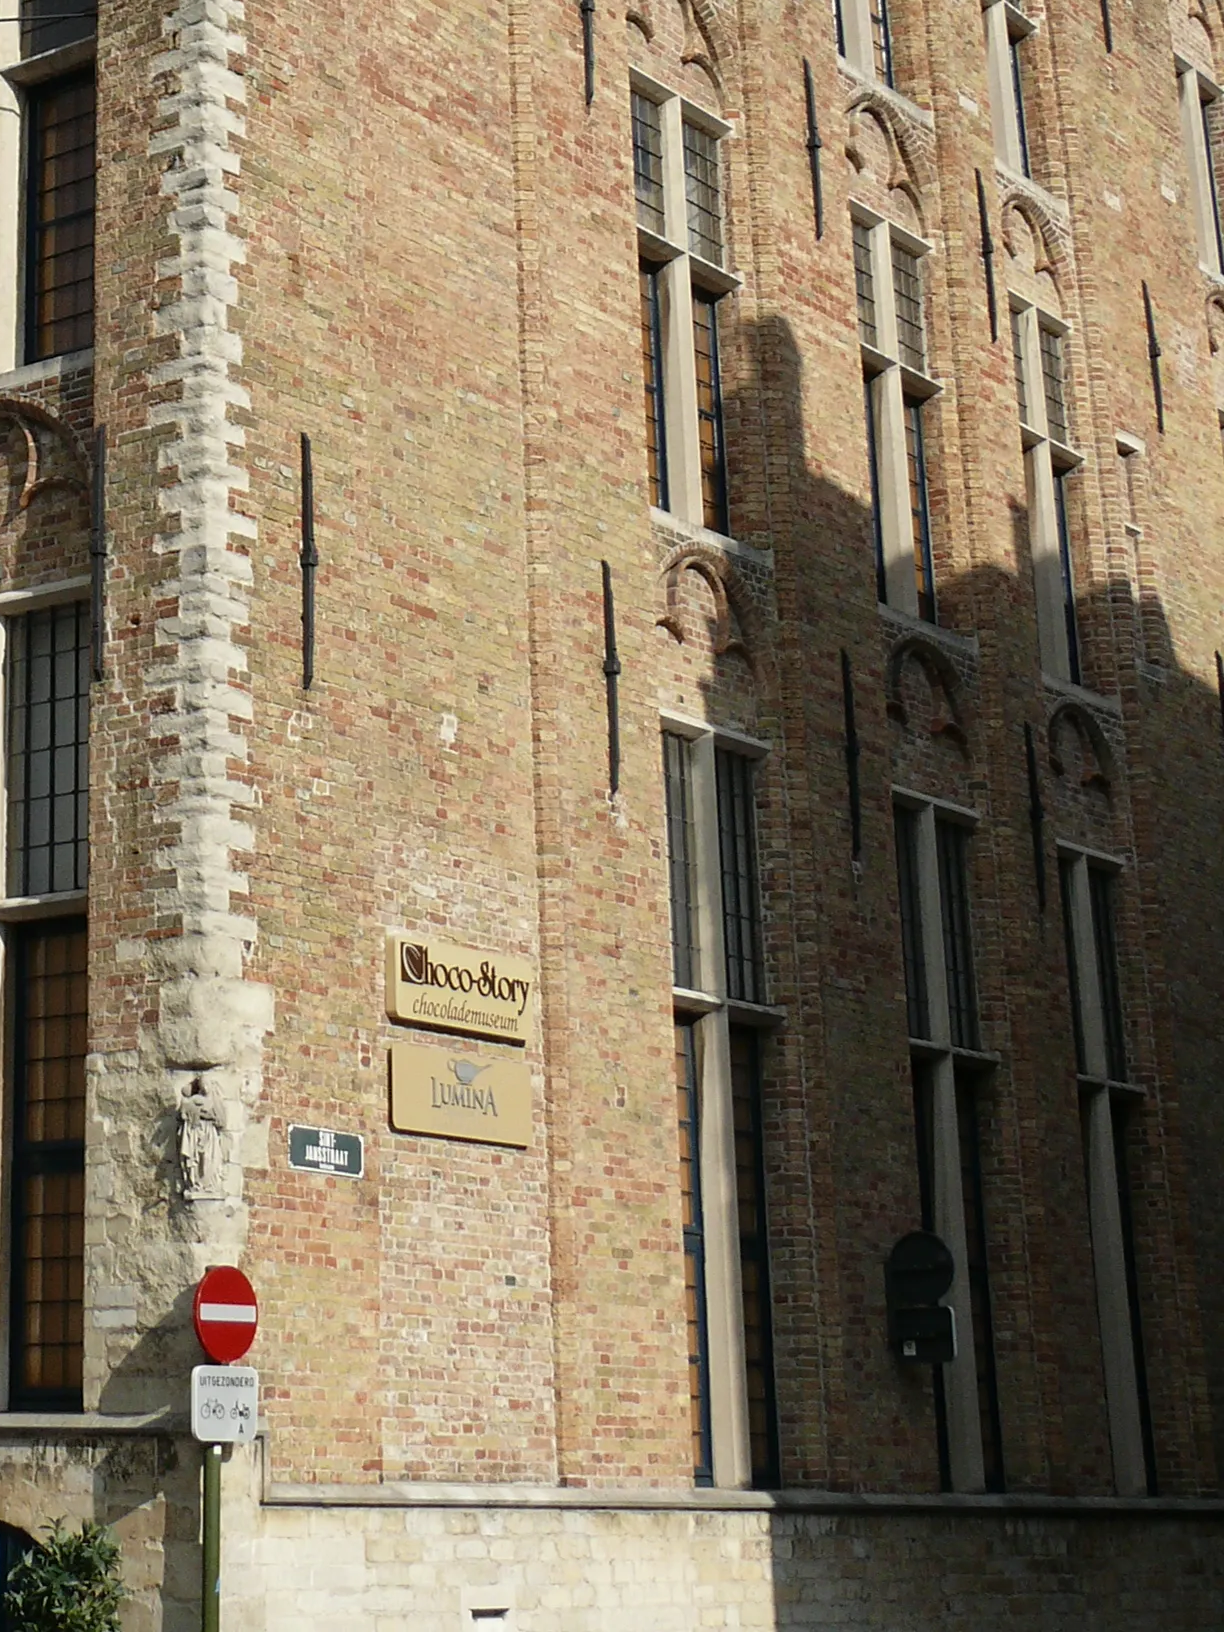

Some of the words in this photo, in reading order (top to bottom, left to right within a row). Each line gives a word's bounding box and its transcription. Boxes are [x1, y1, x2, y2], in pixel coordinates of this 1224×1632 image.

[400, 941, 530, 1016] Choco-Story
[413, 992, 519, 1032] chocolademuseum
[430, 1076, 498, 1118] LUMINA
[199, 1375, 254, 1387] UITGEZONDERD
[239, 1423, 244, 1434] A
